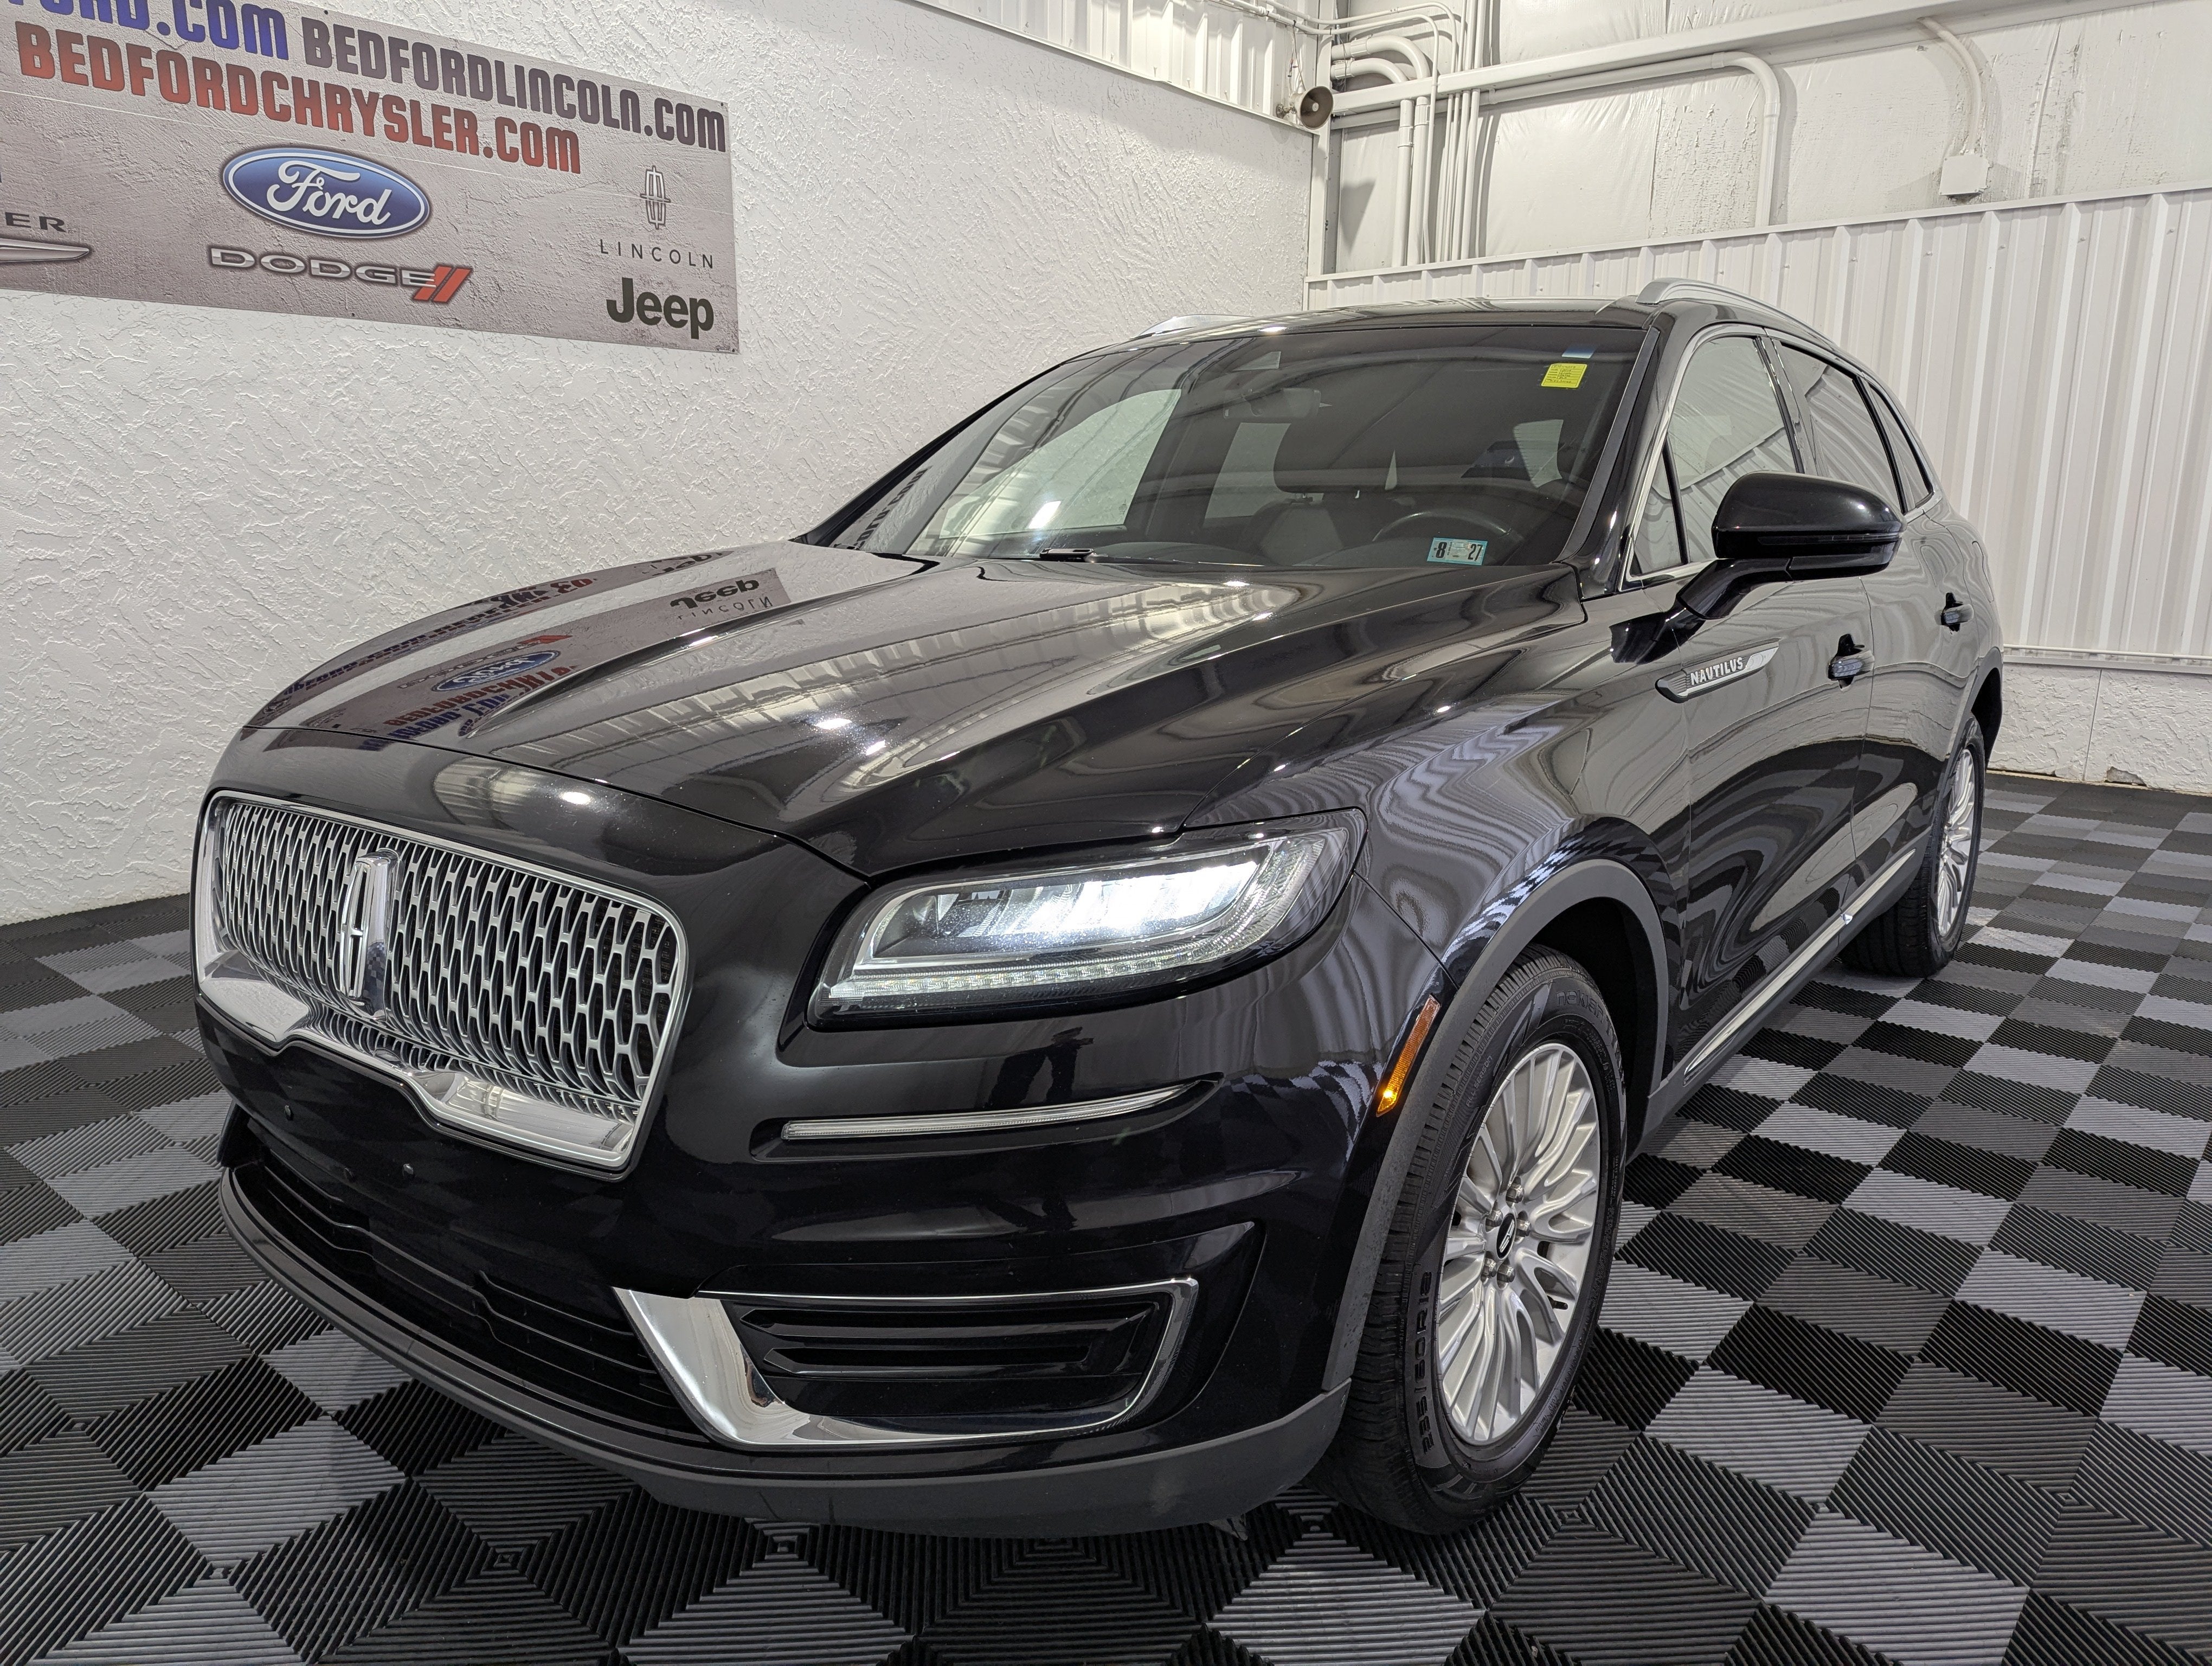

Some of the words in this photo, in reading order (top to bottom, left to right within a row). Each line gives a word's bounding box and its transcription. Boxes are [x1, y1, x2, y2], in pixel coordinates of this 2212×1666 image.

[9, 0, 289, 60] D.COM
[301, 16, 726, 153] BEDFORDLINCOLN.COM
[15, 21, 581, 175] BEDFORDCHRYSLER.COM
[266, 160, 392, 225] Ford
[210, 248, 437, 289] DODGE
[600, 239, 713, 269] LINCOLN
[606, 277, 714, 339] Jeep
[1436, 542, 1447, 558] 8
[1467, 544, 1483, 561] 27
[1690, 657, 1744, 685] NAUTILUS
